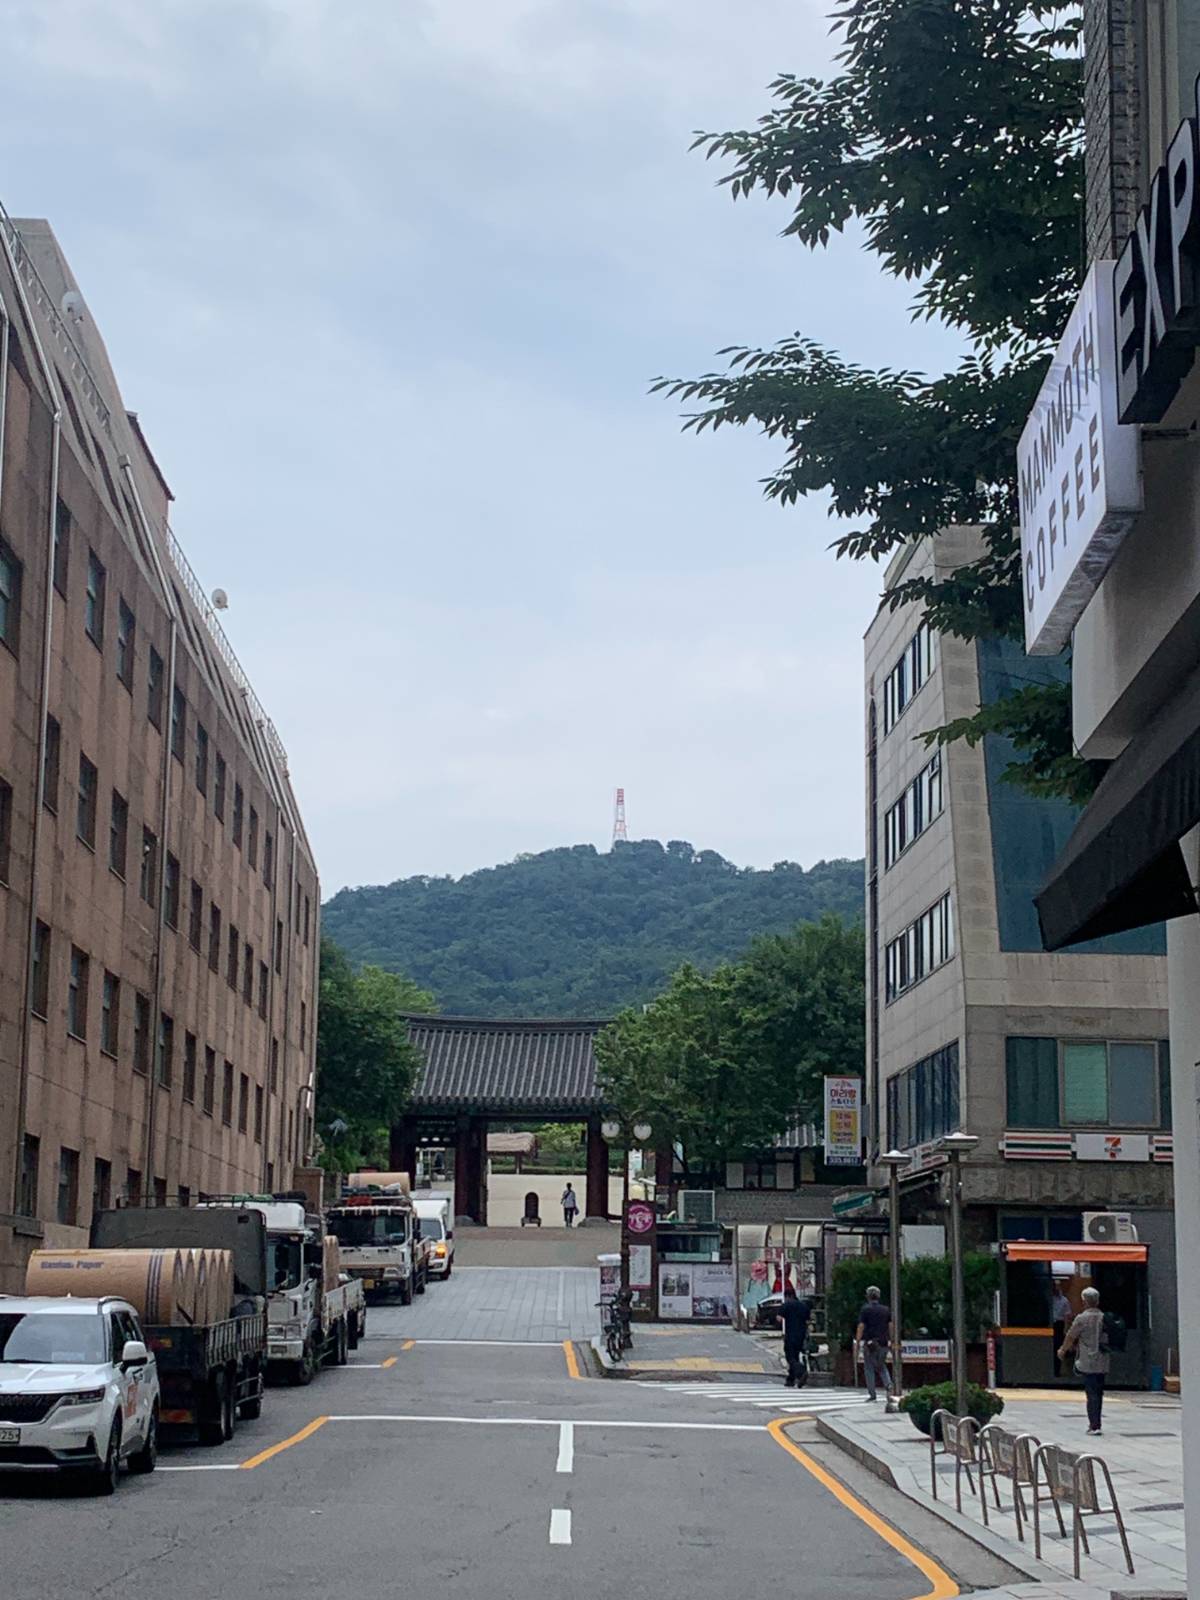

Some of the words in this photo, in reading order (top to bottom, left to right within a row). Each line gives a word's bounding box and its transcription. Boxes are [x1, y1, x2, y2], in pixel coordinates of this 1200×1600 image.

[1113, 76, 1200, 424] EXP
[1021, 311, 1096, 528] MAMMOTH
[1027, 413, 1100, 613] COFFEE
